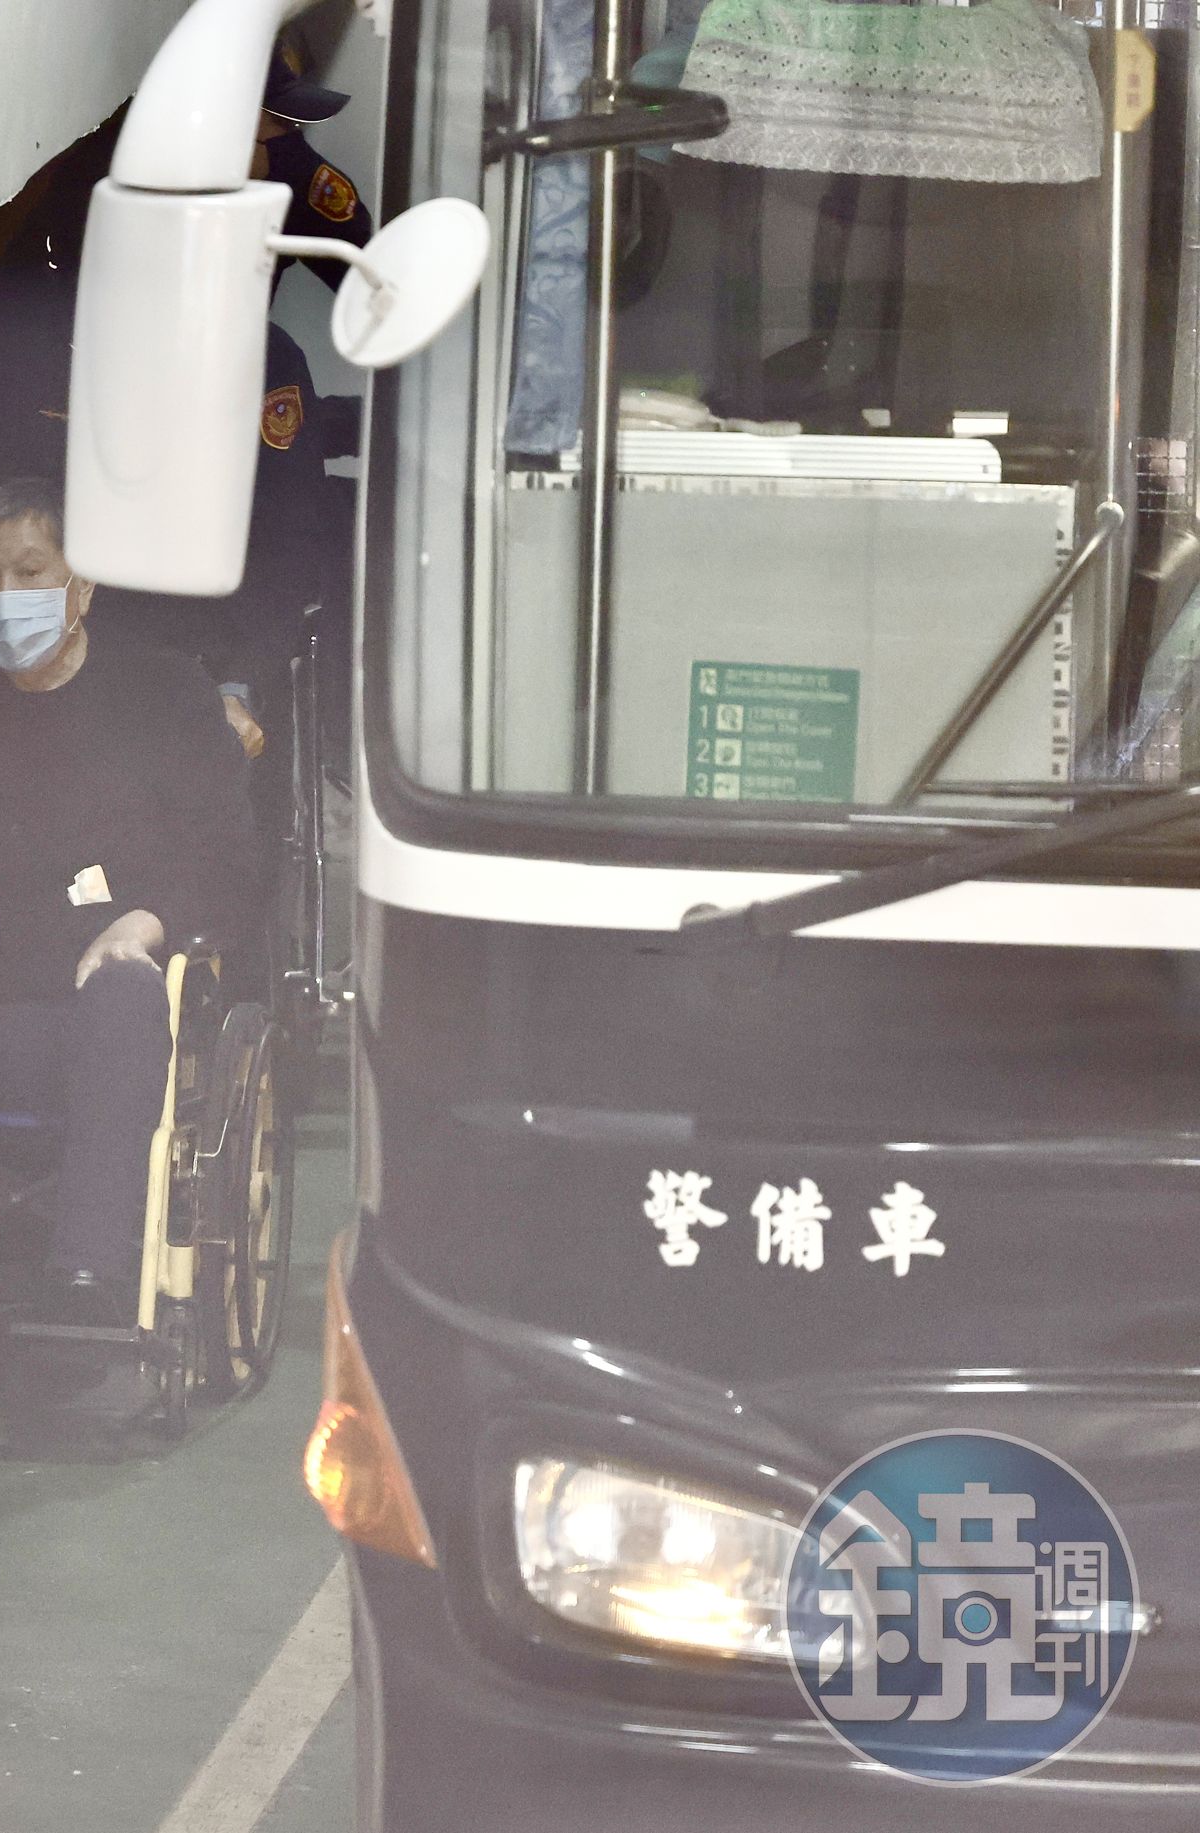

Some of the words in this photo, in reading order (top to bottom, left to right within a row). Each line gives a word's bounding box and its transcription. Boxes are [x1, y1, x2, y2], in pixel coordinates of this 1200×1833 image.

[700, 704, 709, 729] 1
[697, 738, 710, 763] 2
[694, 772, 709, 798] 3
[644, 1169, 945, 1277] 警備車
